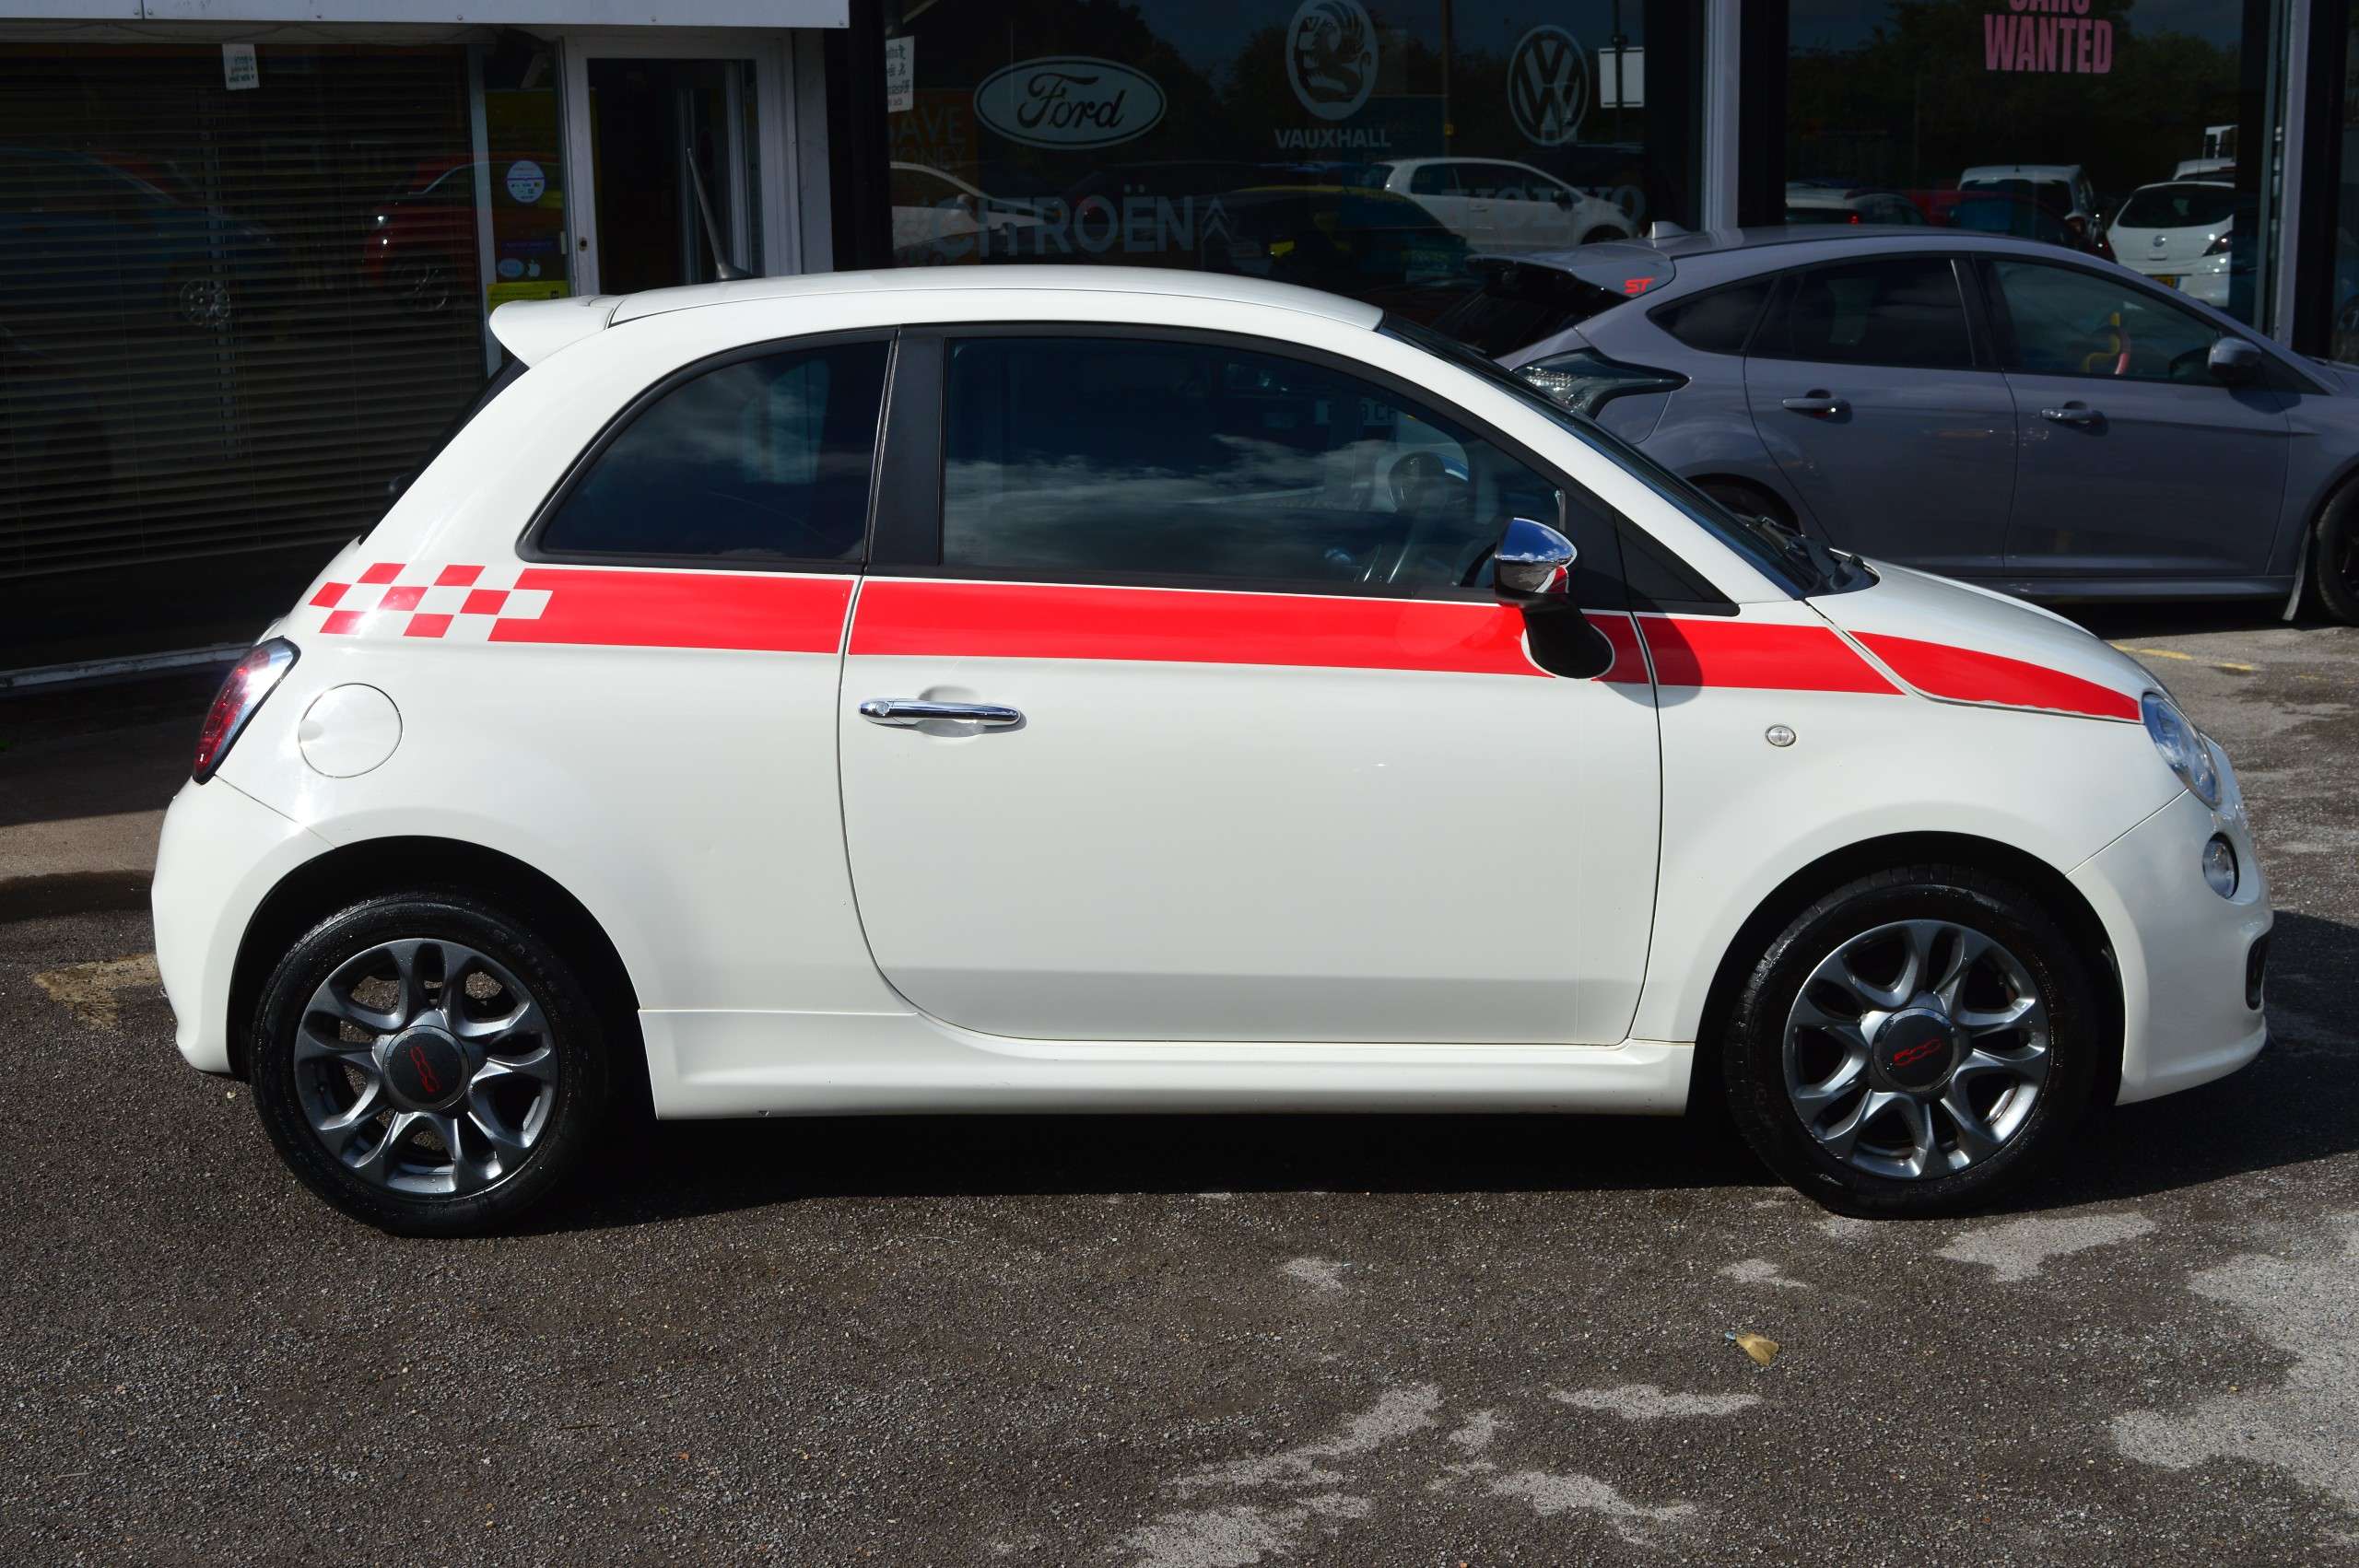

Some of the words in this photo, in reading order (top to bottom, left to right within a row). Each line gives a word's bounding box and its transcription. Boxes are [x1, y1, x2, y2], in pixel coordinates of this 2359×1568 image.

[1984, 14, 2113, 74] WANTED
[1017, 73, 1126, 128] Ford
[888, 103, 967, 146] AVE
[1274, 127, 1392, 148] VAUXHALL
[1624, 276, 1654, 294] ST
[1894, 1038, 1942, 1066] 500
